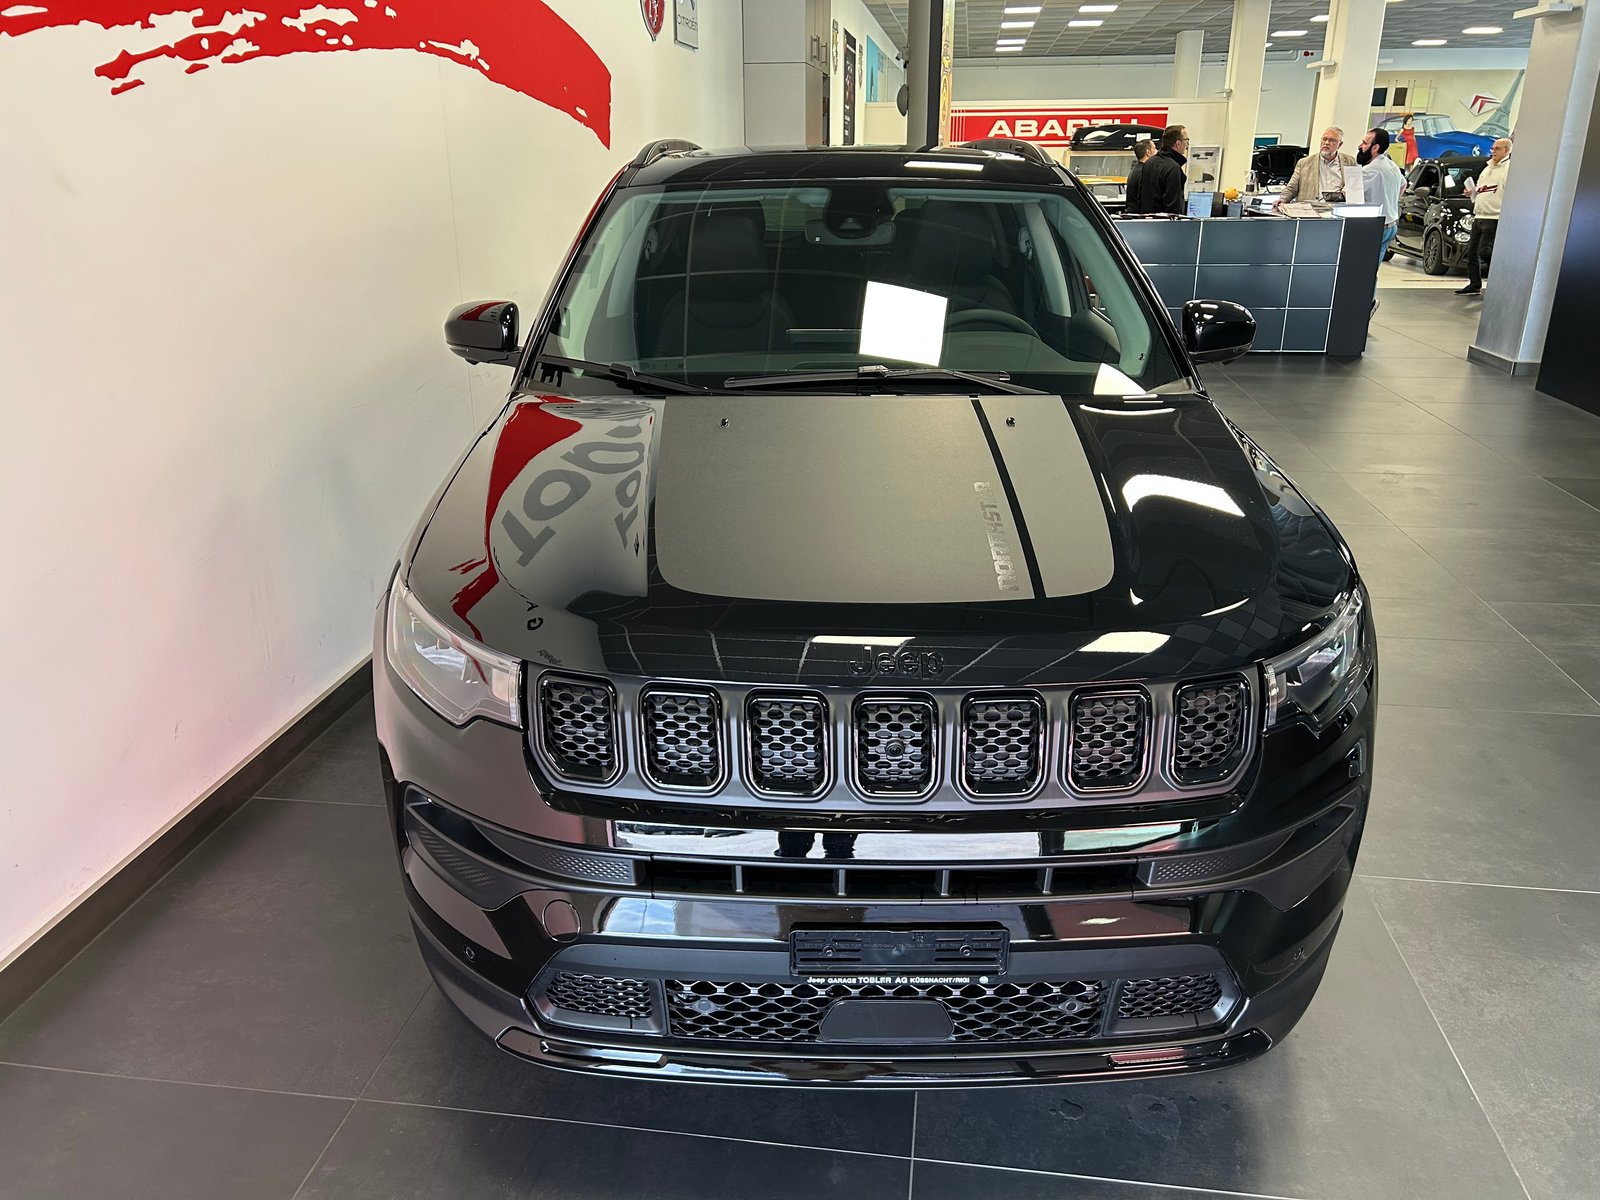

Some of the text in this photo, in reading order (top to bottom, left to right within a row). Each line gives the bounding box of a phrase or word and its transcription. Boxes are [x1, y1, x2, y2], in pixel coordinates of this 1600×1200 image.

[848, 645, 944, 680] Jeep
[806, 976, 826, 985] Jeep
[857, 976, 892, 984] TOBLER
[894, 976, 908, 984] AG
